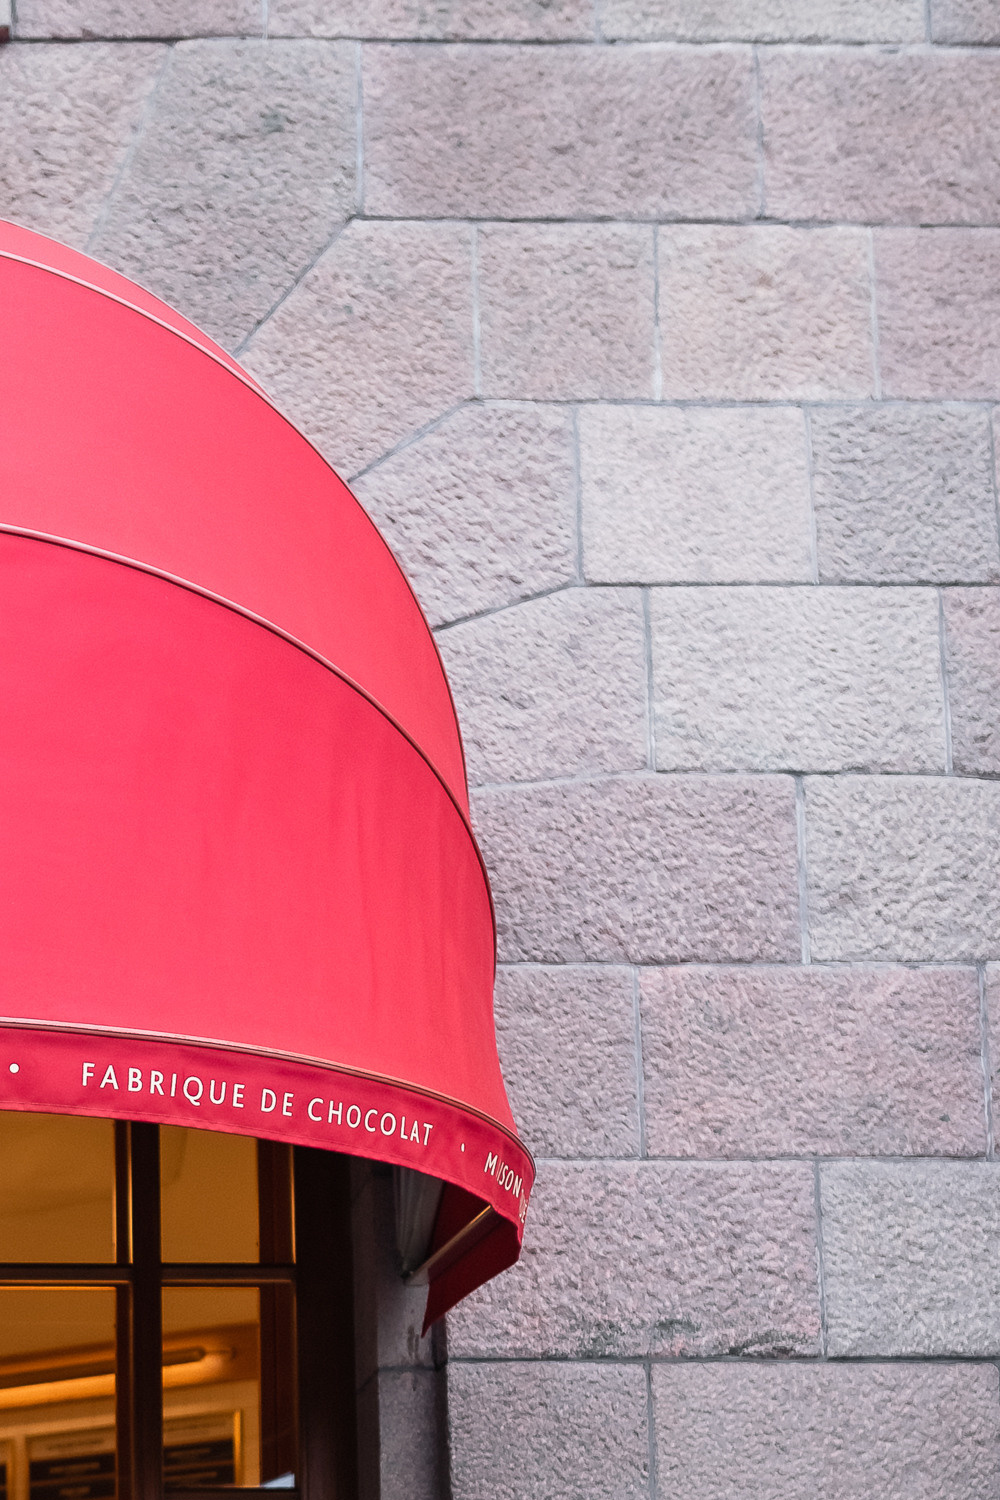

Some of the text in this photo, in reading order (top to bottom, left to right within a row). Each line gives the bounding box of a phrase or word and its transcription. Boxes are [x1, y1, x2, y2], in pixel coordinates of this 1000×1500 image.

[82, 1062, 433, 1146] FABRIQUE DE CHOCOLAT
